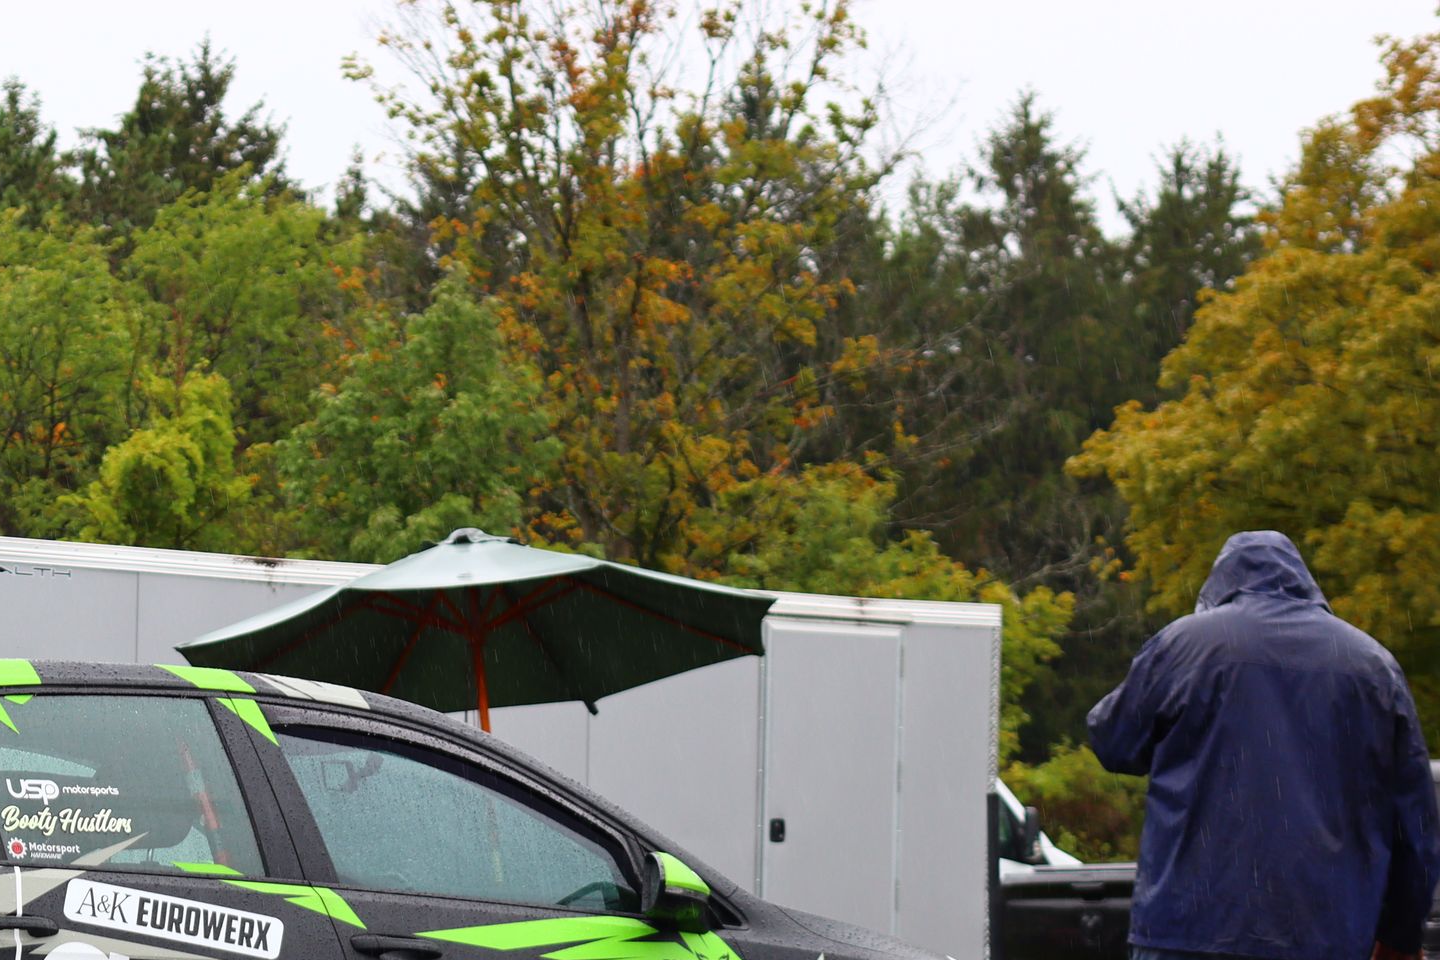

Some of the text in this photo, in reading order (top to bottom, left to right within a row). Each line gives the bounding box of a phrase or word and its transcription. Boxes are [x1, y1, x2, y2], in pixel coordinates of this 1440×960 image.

[62, 785, 120, 797] motorsports
[1, 805, 132, 836] Booty Hustlers
[28, 842, 81, 854] Motorsport
[75, 887, 272, 951] A&K EUROWERX
